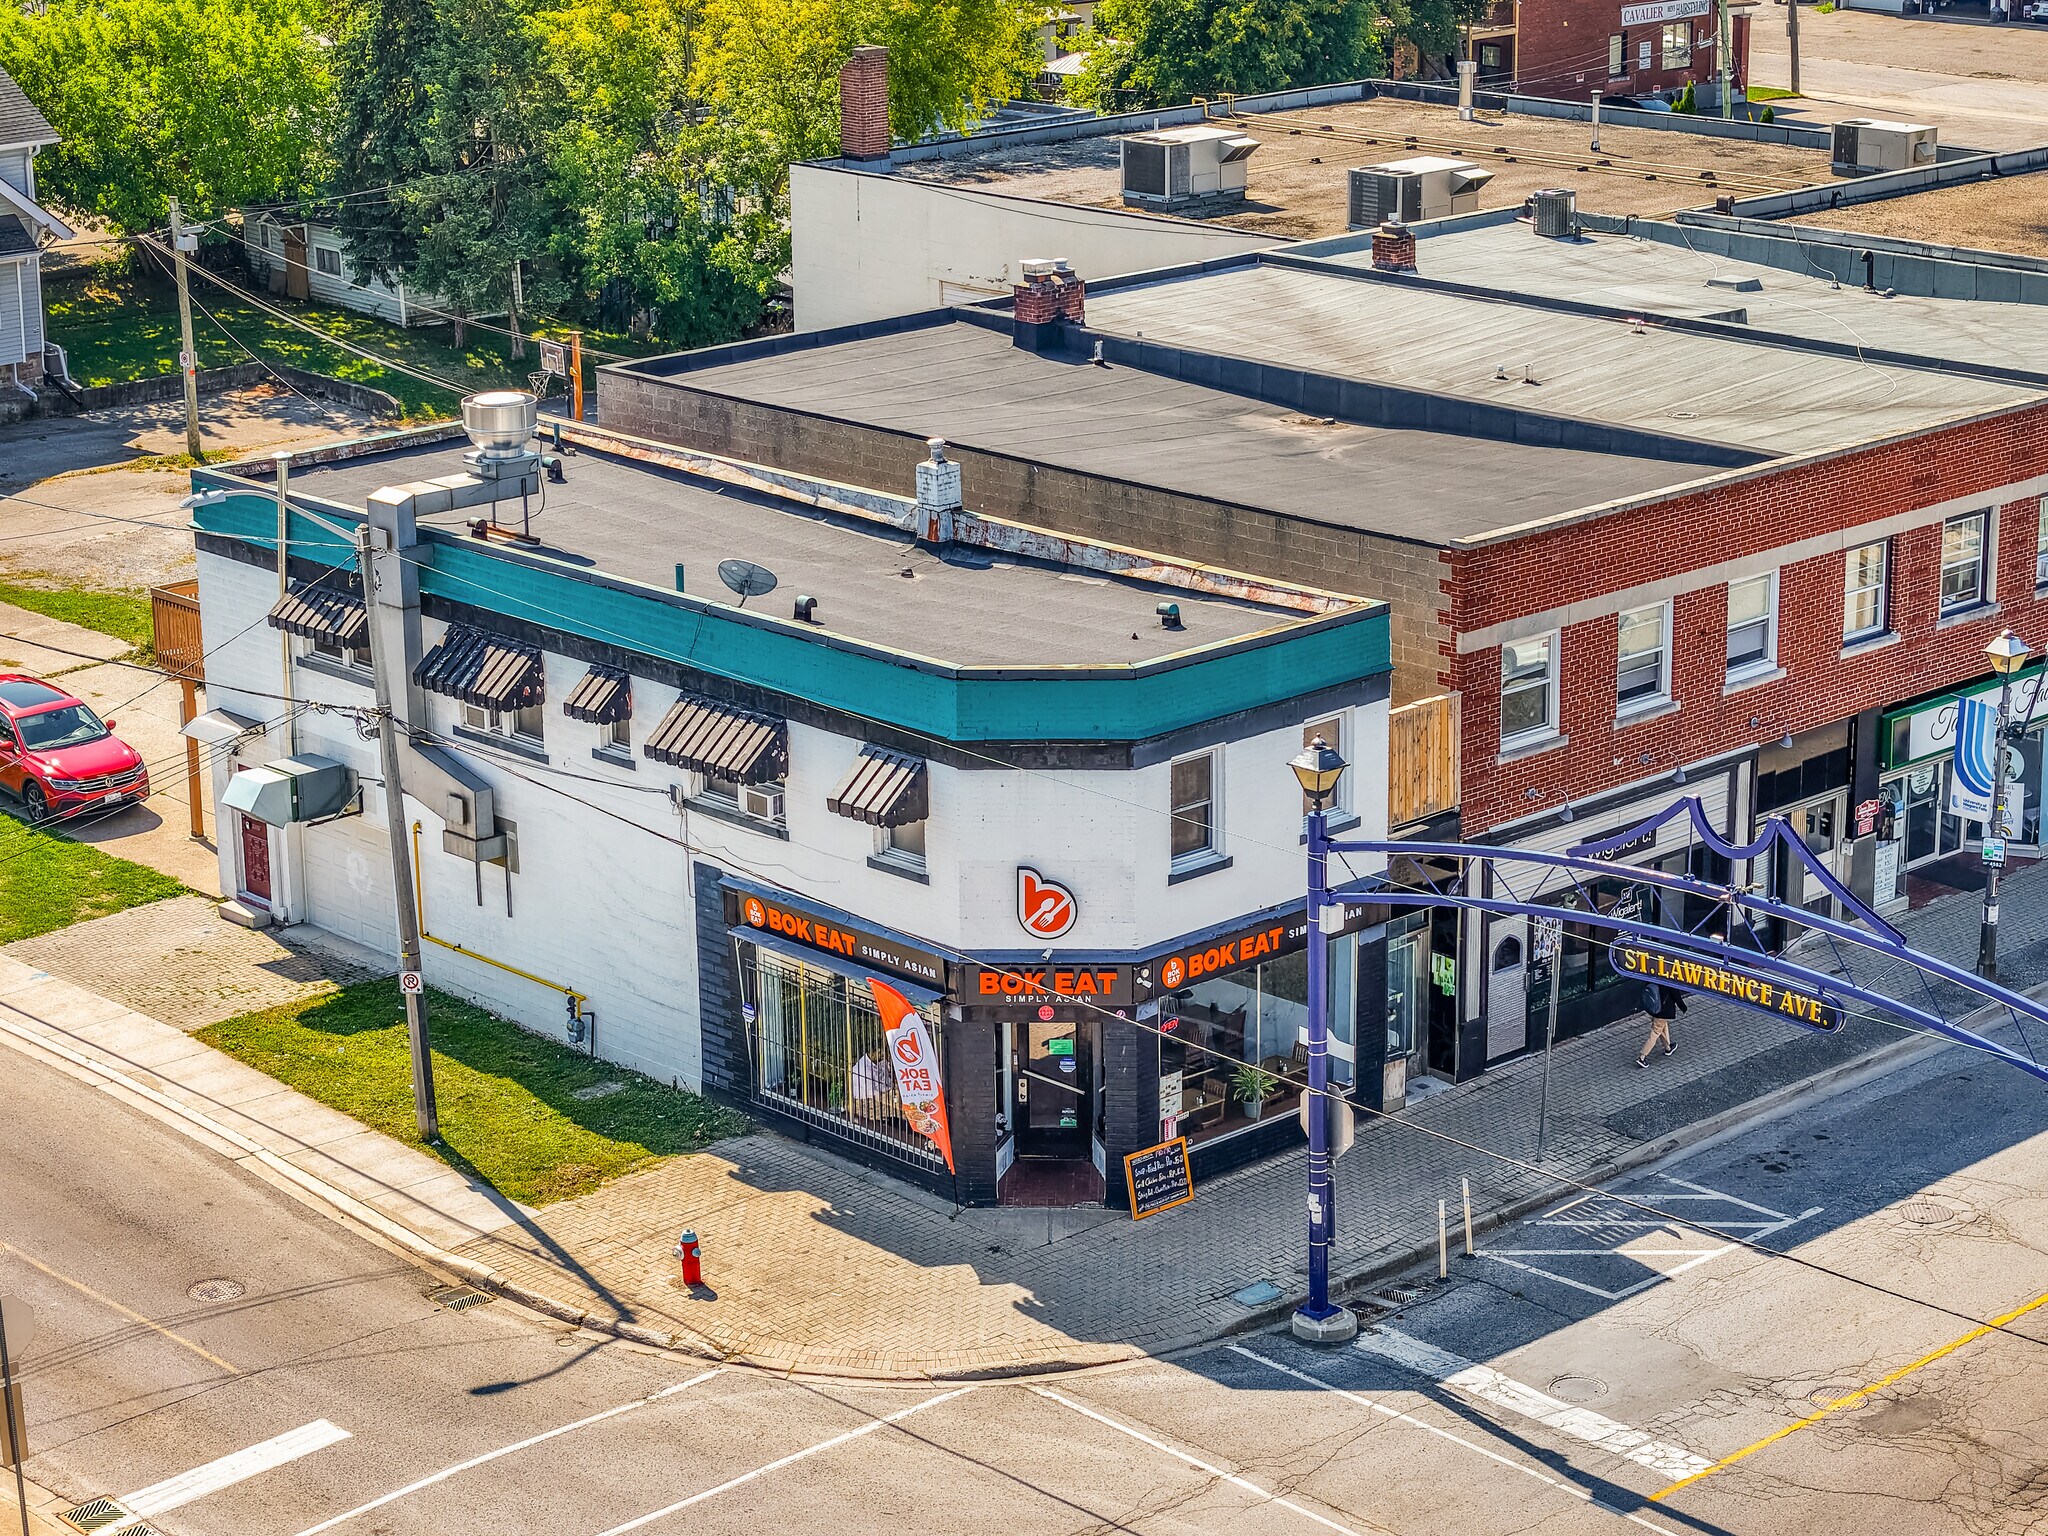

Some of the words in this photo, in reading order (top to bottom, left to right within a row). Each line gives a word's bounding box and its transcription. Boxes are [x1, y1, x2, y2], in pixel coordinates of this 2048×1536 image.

[1623, 5, 1664, 23] CAVALIER
[767, 907, 812, 942] BOK
[814, 924, 857, 957] EAT
[861, 945, 901, 967] SIMPLY
[904, 959, 938, 979] ASIAN
[1188, 941, 1236, 978] BOK
[1239, 926, 1284, 962] EAT
[979, 971, 1046, 995] BOK
[1055, 972, 1118, 995] EAT
[1005, 995, 1050, 1003] SIMPLY
[1778, 990, 1828, 1026] AVE.
